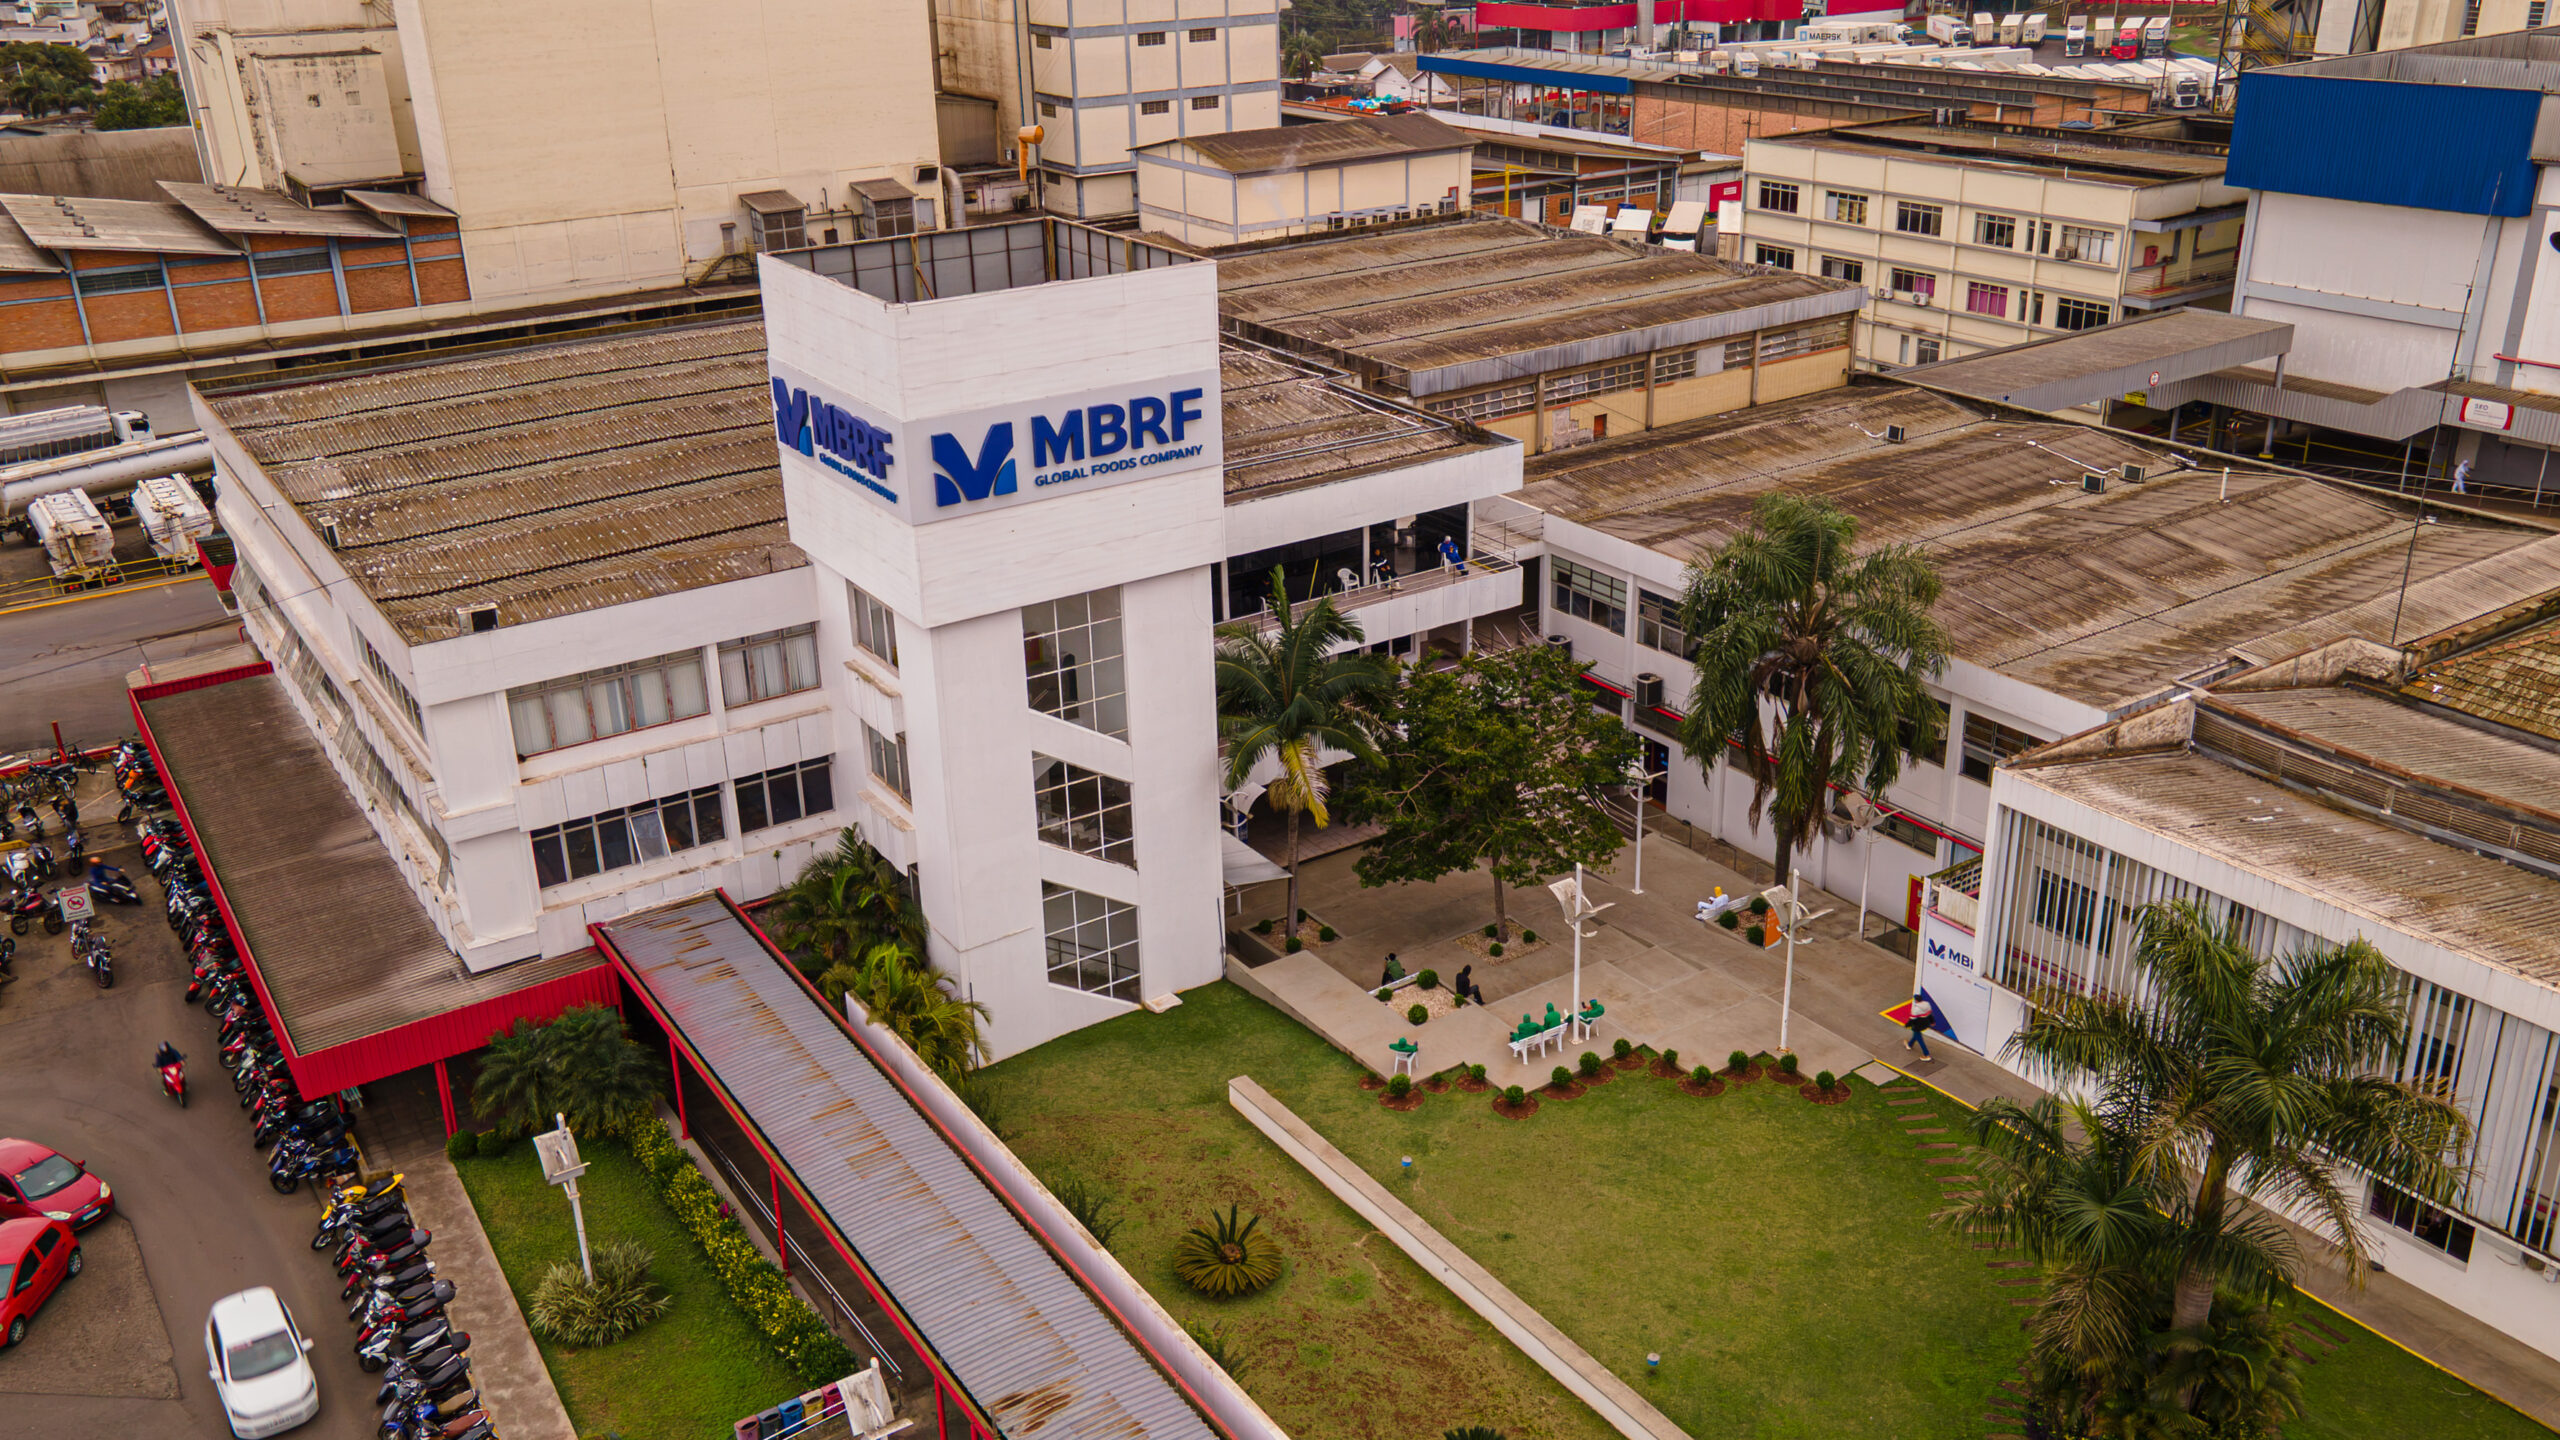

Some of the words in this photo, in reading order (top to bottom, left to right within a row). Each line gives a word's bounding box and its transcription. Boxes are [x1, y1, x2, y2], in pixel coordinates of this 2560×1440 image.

[1809, 32, 1842, 41] MAERSK
[809, 395, 894, 480] MBRF
[1031, 387, 1203, 468] MBRF
[1034, 467, 1089, 487] GLOBAL
[1091, 457, 1137, 476] FOODS
[1140, 444, 1204, 466] COMPANY
